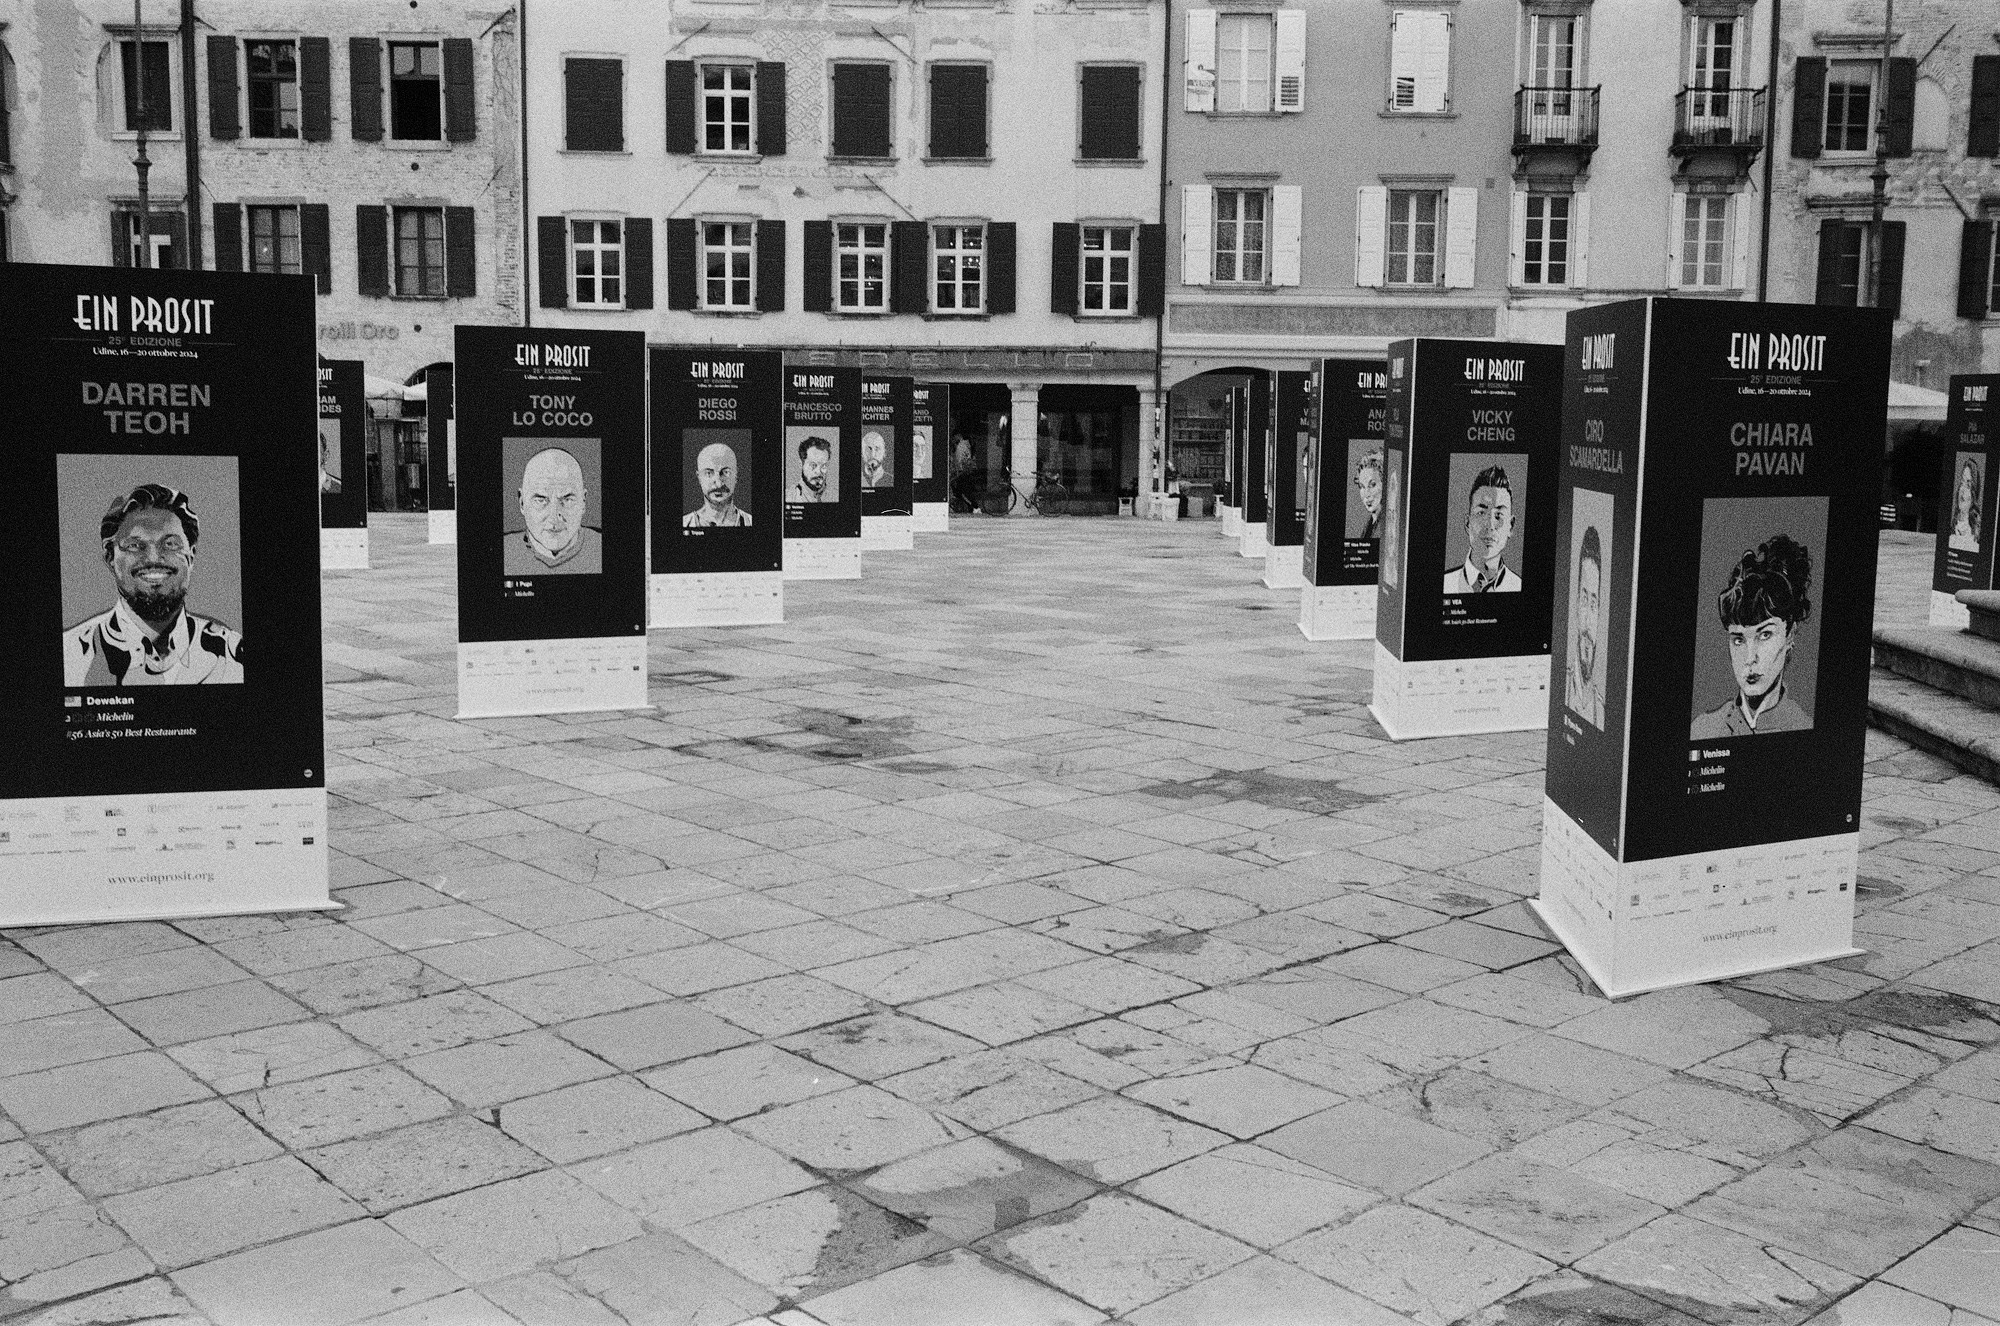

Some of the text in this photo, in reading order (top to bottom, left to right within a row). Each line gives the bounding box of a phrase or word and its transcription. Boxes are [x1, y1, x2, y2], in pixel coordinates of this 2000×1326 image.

[73, 294, 214, 334] EIN PROSIT
[130, 337, 182, 347] EDIZIONE
[93, 346, 119, 356] Udine,
[148, 348, 179, 358] ottobre
[179, 350, 198, 359] 2024
[514, 344, 591, 367] EIN PROSIT
[1727, 332, 1826, 371] EIN PROSIT
[690, 361, 745, 379] EIN PROSIT
[1464, 358, 1525, 381] EIN PROSIT
[792, 374, 835, 388] EIN PROSIT
[1357, 372, 1387, 389] EIN PR
[1766, 375, 1802, 385] EDIZIONE
[82, 381, 210, 407] DARREN
[529, 395, 576, 410] TONY
[698, 398, 737, 409] DIEGO
[784, 402, 842, 412] FRANCESCO
[513, 411, 593, 426] LO COCO
[699, 409, 737, 420] ROSSI
[794, 411, 832, 421] BRUTTO
[1472, 409, 1513, 424] VICKY
[103, 410, 190, 435] TEOH
[1467, 426, 1515, 441] CHENG
[1585, 419, 1604, 442] CIRO
[1730, 422, 1813, 447] CHIARA
[1736, 452, 1805, 476] PAVAN
[86, 696, 135, 706] Dewakan
[96, 712, 135, 722] Michelin
[85, 728, 111, 739] Asia's
[111, 729, 123, 740] 50
[124, 728, 143, 738] Best
[144, 727, 197, 737] Restaurants
[1703, 748, 1731, 759] Venissa
[1699, 765, 1726, 777] Michelin
[1699, 781, 1726, 793] Michelin
[108, 869, 215, 886] www.einprosit.org
[1702, 924, 1778, 942] www.einprosit.org
